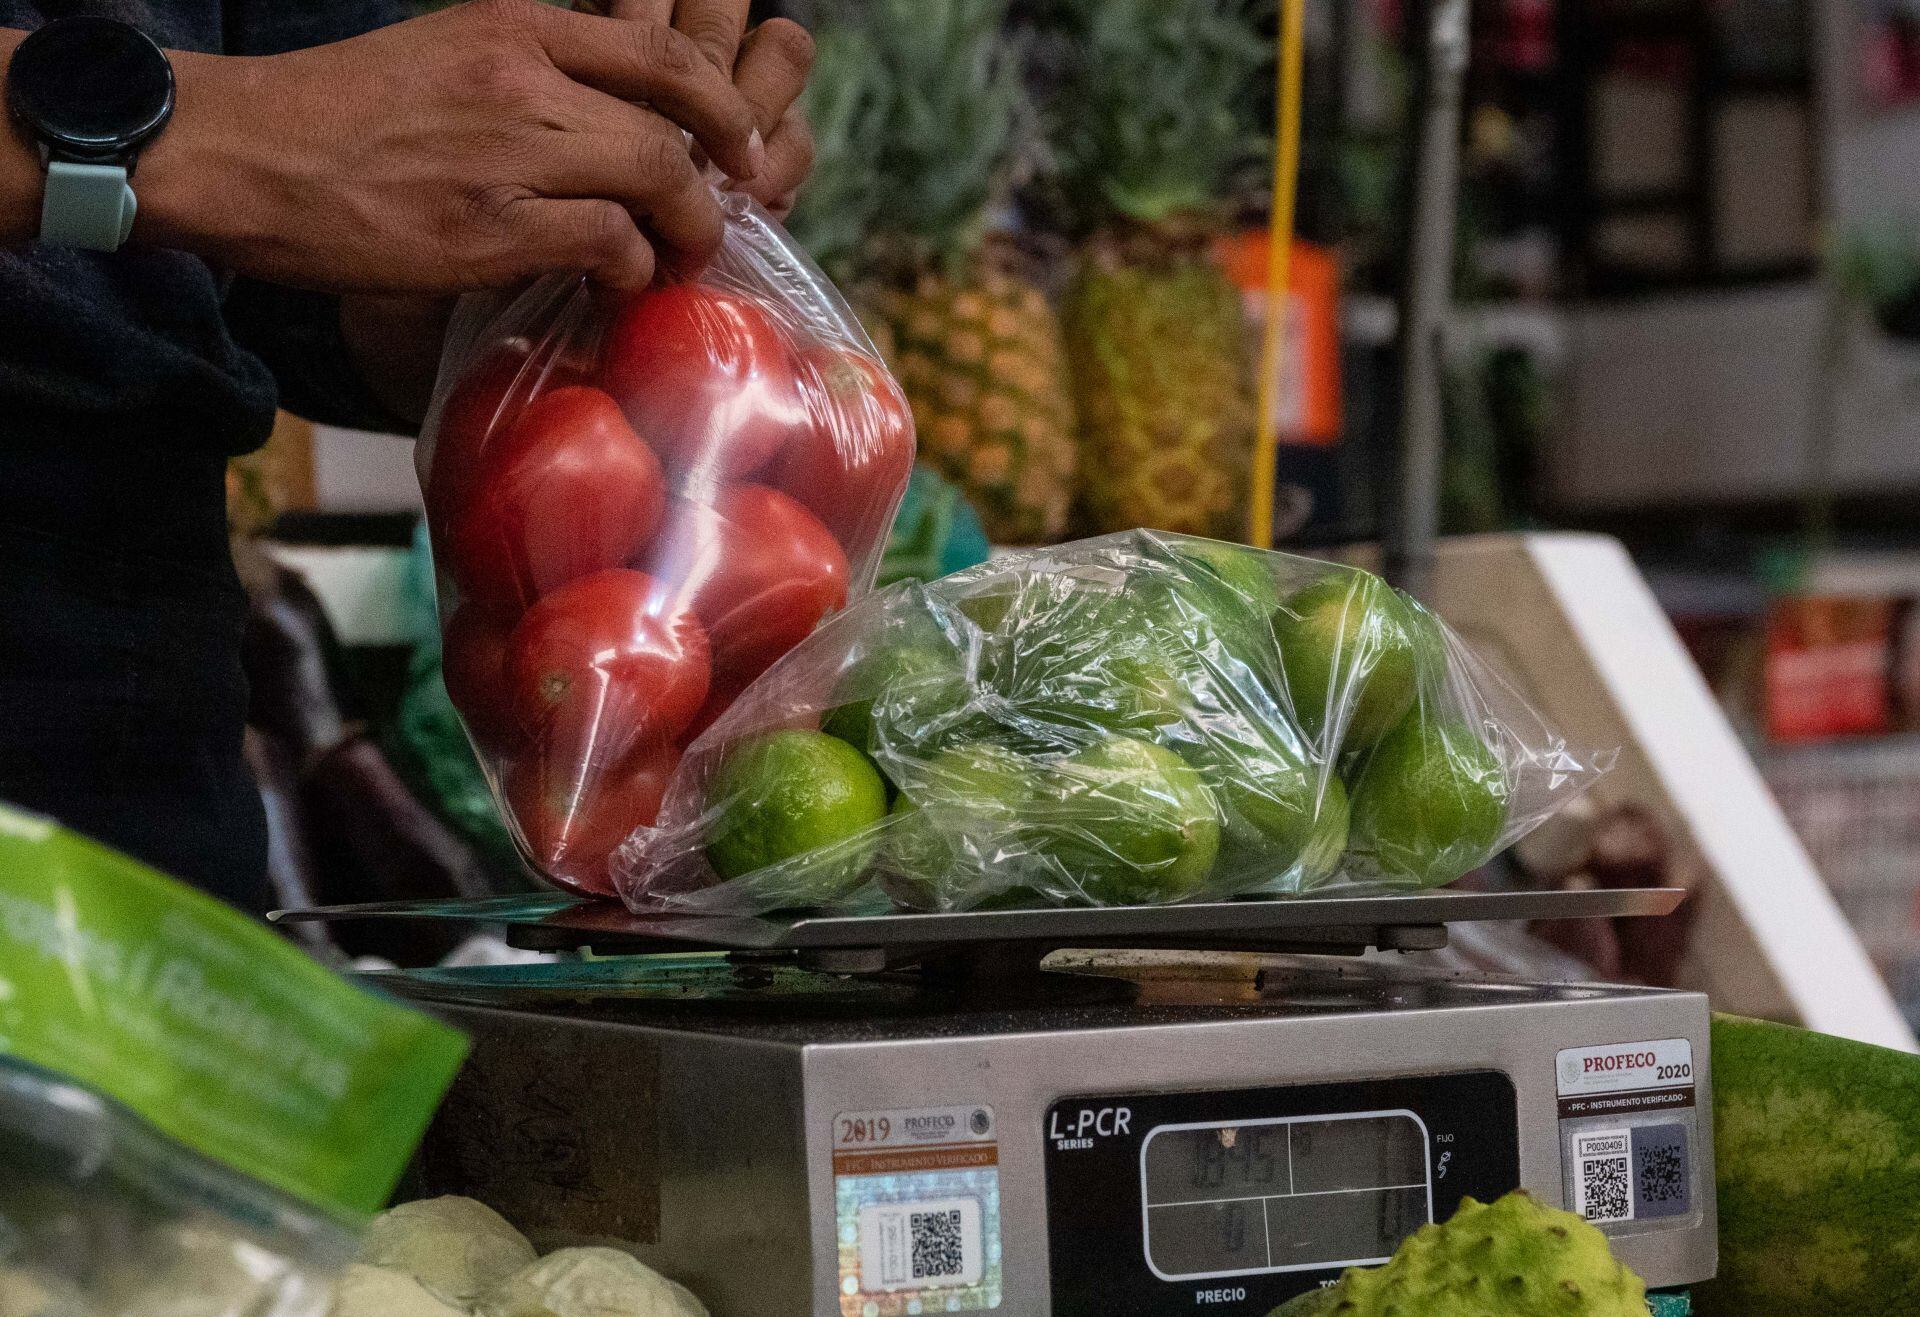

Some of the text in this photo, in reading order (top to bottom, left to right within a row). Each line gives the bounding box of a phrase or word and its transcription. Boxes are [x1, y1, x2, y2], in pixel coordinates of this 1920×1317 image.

[1583, 1052, 1656, 1073] PROFECO
[1656, 1064, 1691, 1081] 2020
[1590, 1098, 1641, 1110] INSTRUMENTO
[1641, 1094, 1683, 1105] VERIFICADO
[841, 1117, 891, 1143] 2019
[904, 1114, 955, 1130] PROFECO
[1050, 1107, 1131, 1139] L-PCR
[1057, 1138, 1094, 1151] SERIES
[1436, 1133, 1454, 1143] FIJO
[1586, 1140, 1623, 1152] P0030409
[1196, 1287, 1246, 1304] PRECIO
